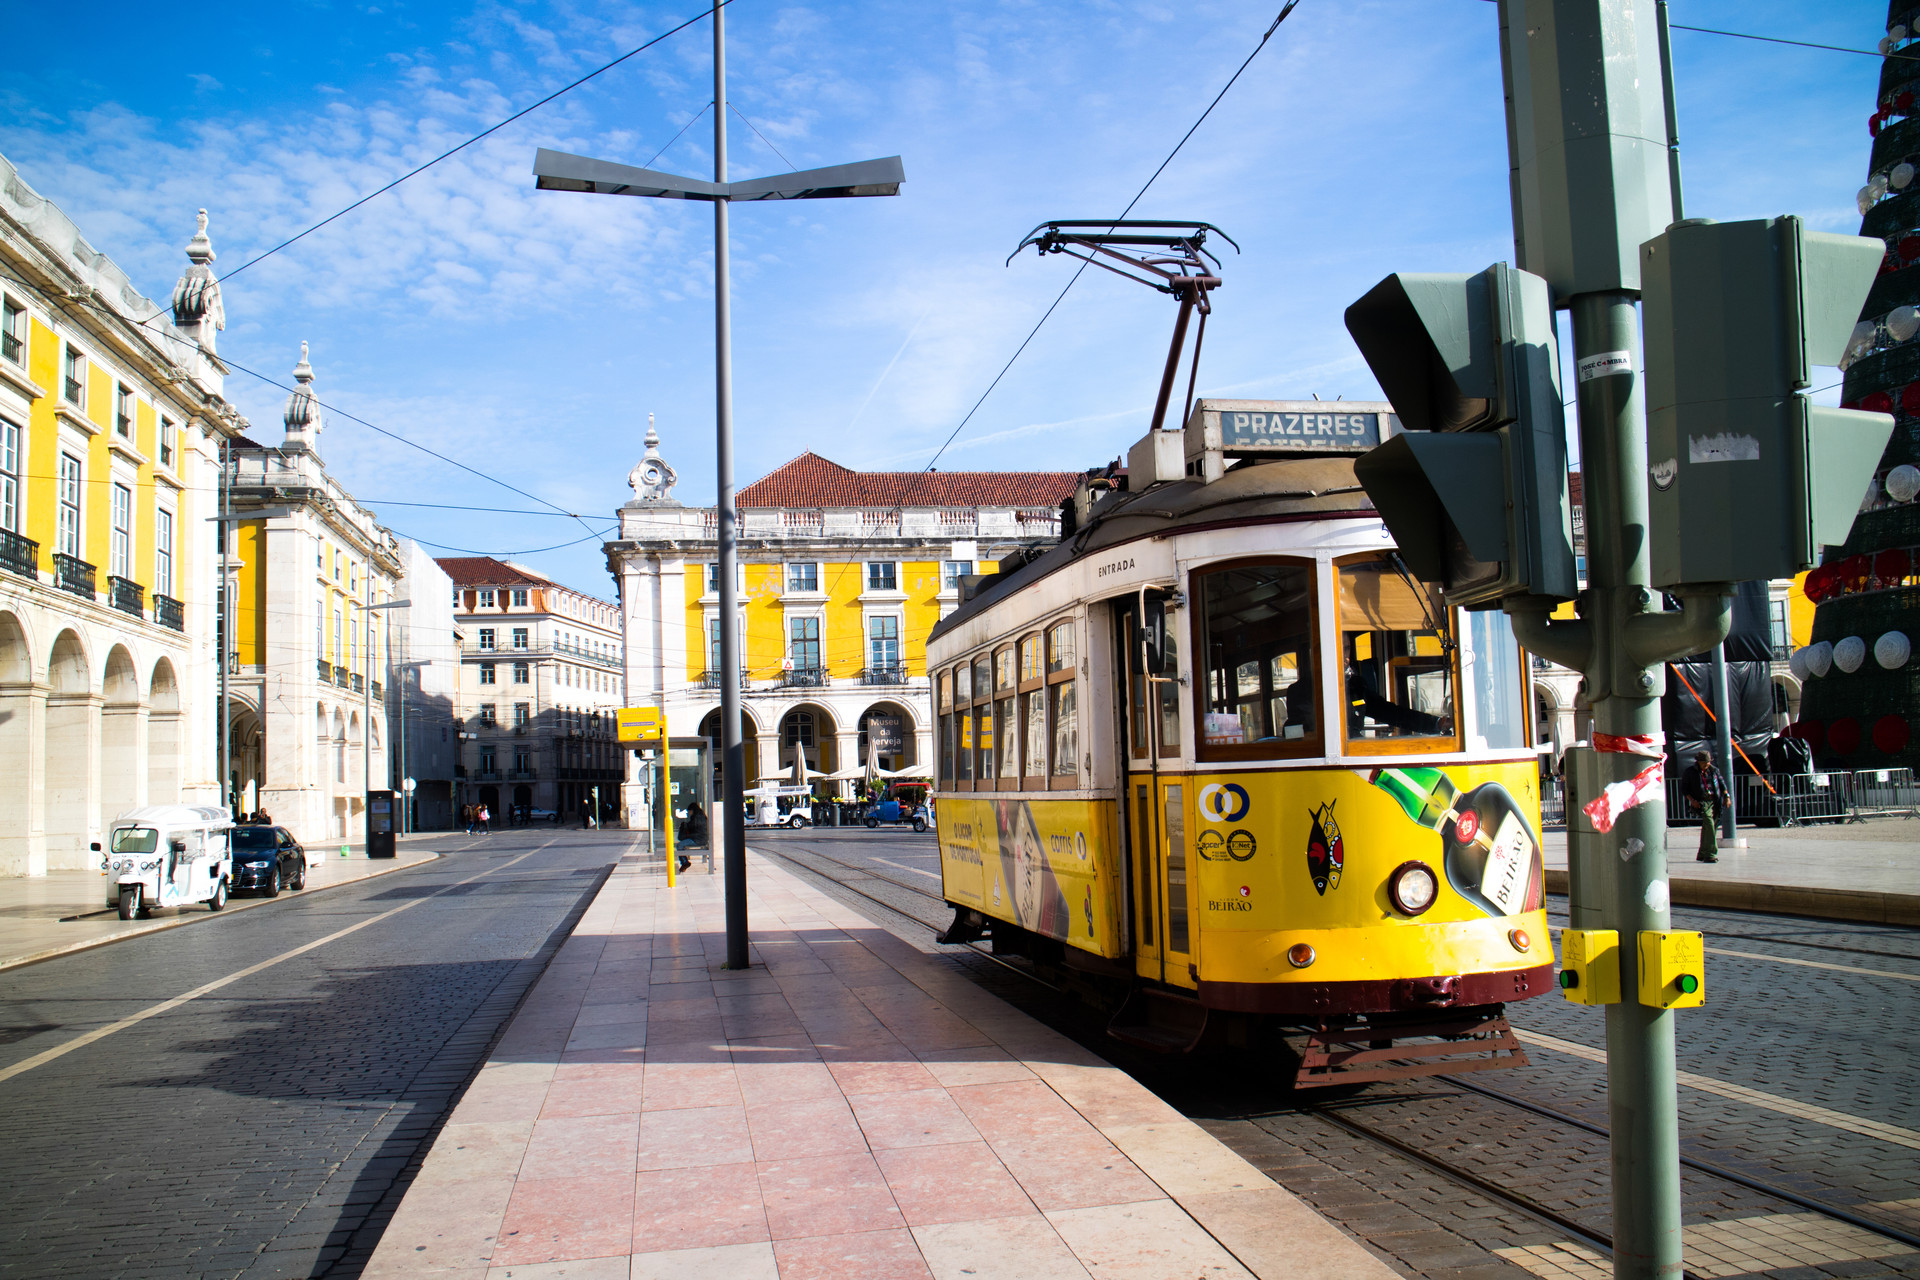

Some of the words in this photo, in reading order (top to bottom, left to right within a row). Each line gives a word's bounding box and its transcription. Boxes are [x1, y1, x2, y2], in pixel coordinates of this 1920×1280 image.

[1234, 413, 1365, 435] PRAZERES
[1099, 558, 1135, 577] ENTRADA
[1497, 831, 1523, 904] BEIRÃO
[1209, 900, 1252, 912] BEIRÃO
